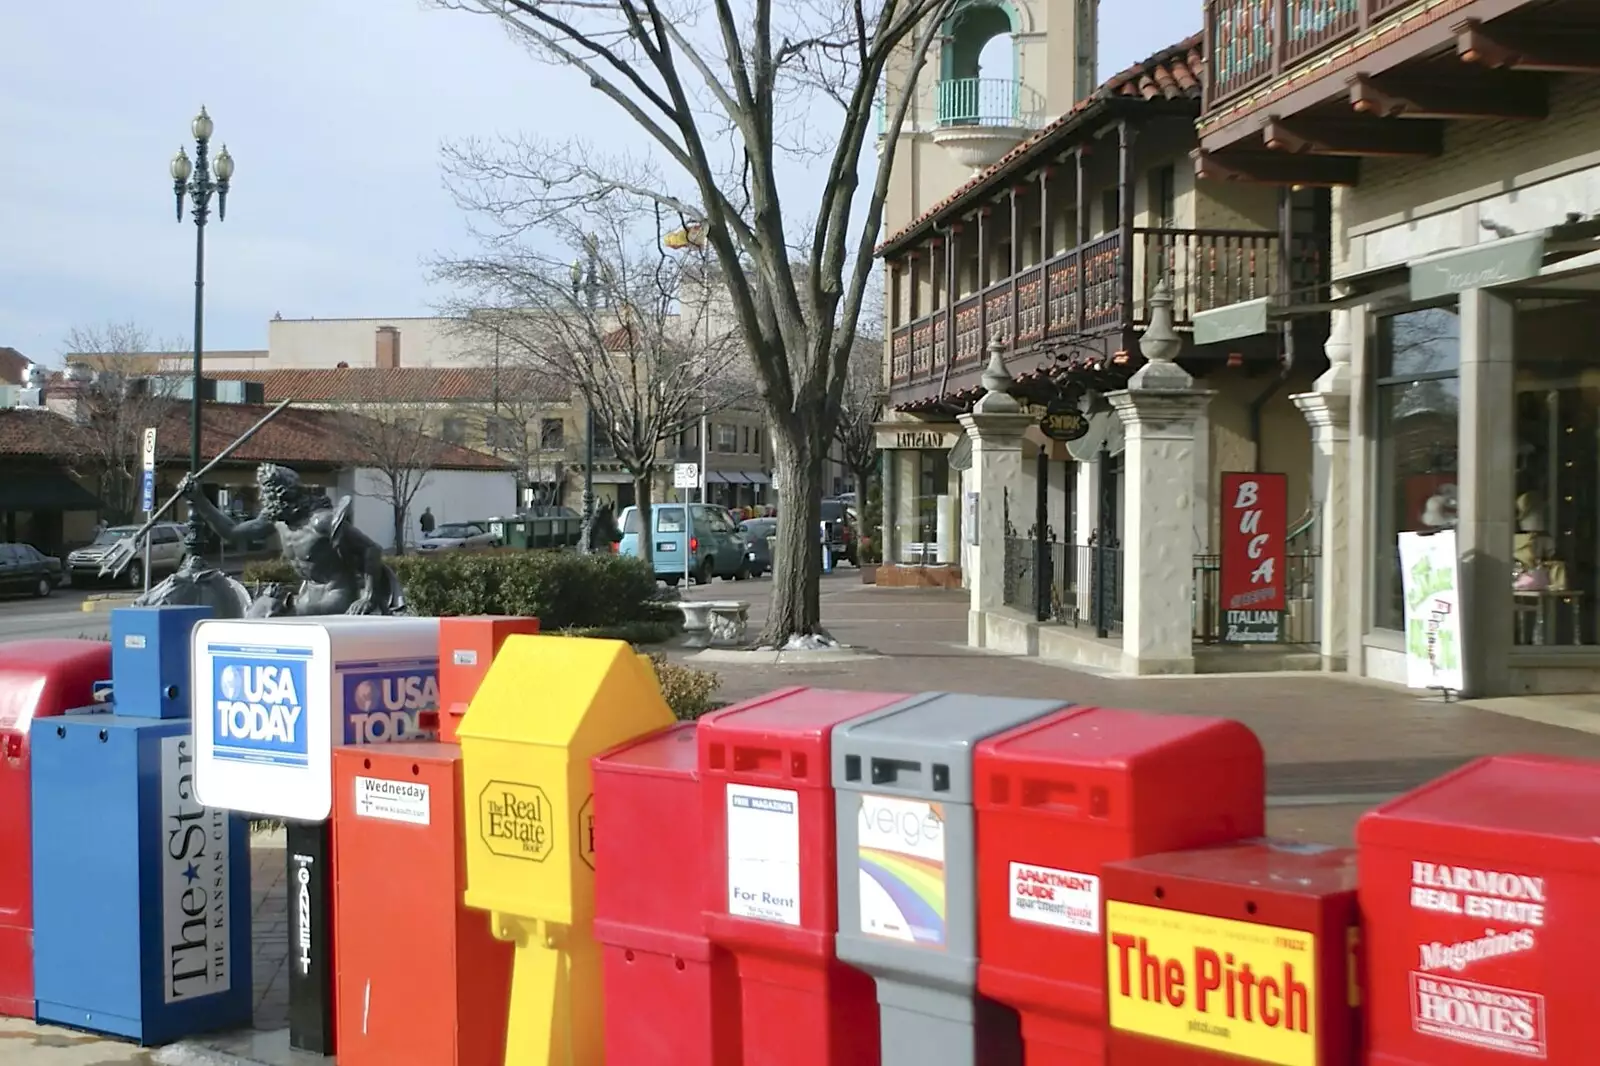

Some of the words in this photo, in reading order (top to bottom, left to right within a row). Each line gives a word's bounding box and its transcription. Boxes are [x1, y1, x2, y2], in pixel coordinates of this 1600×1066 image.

[1233, 480, 1276, 584] BUCA
[1227, 610, 1278, 624] ITALIAN
[243, 665, 299, 705] USA
[382, 675, 440, 711] USA
[217, 700, 302, 743] TODAY
[365, 778, 426, 802] Wednesday
[487, 800, 504, 814] The
[502, 791, 542, 822] Real
[488, 811, 545, 845] Estate
[860, 803, 940, 847] verge
[213, 851, 224, 929] KANSAS
[733, 886, 758, 901] For
[762, 891, 794, 908] Rent
[1016, 868, 1093, 892] APARTMENT
[1016, 883, 1055, 900] GUIDE
[1411, 861, 1546, 901] HARMON
[297, 867, 311, 974] GANNETT
[1410, 886, 1463, 914] REAL
[1464, 895, 1544, 926] ESTATE
[171, 886, 208, 998] The
[214, 941, 224, 983] THE
[1418, 928, 1535, 972] Magazines
[1111, 931, 1186, 1008] The
[1193, 945, 1310, 1034] Pitch
[1417, 978, 1535, 1014] HARMON
[1418, 993, 1535, 1040] HOMES
